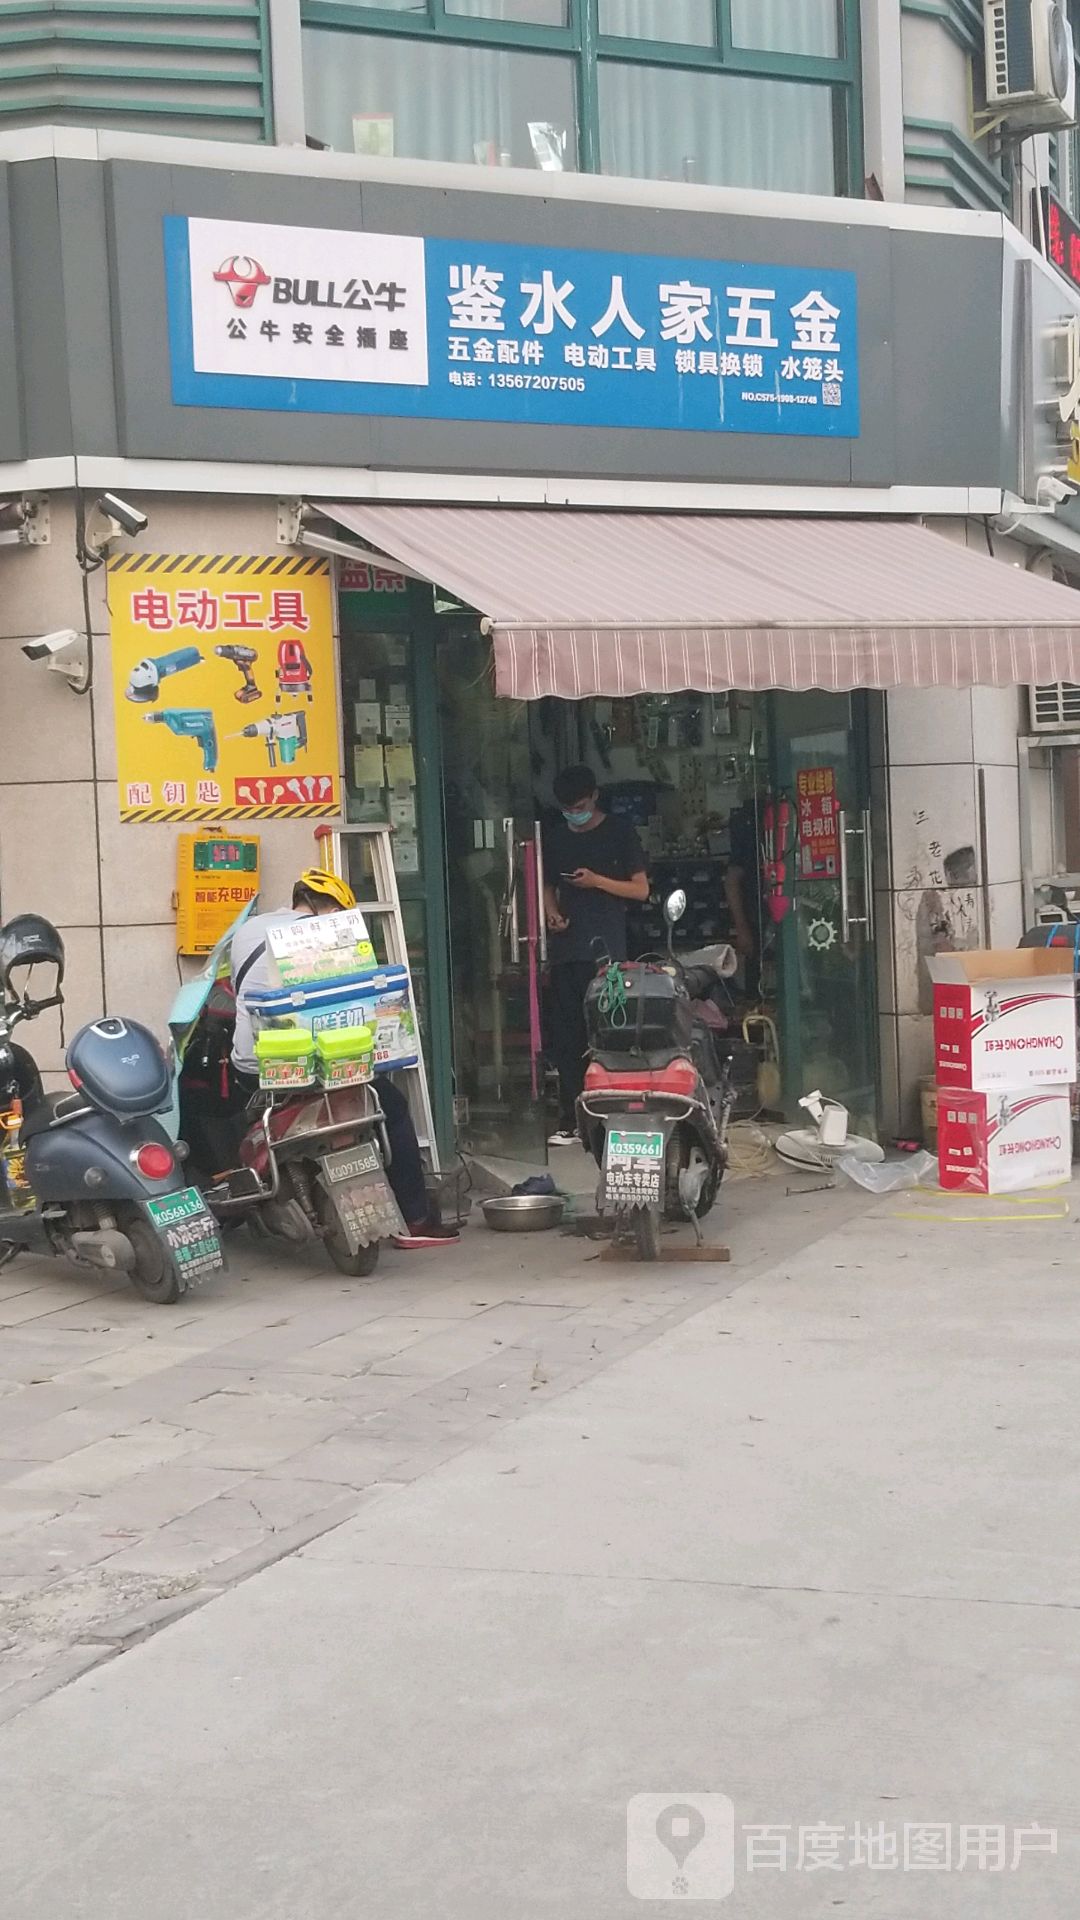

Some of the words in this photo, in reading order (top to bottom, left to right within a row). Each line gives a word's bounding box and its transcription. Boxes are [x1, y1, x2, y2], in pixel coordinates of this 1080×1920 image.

[447, 264, 841, 352] 鉴水人家五金
[226, 317, 409, 351] 公牛安全插座
[447, 336, 545, 366] 五金配件
[563, 342, 657, 373] 电动工具
[674, 349, 764, 378] 锁具换锁
[780, 355, 844, 383] 水笼头
[131, 588, 310, 632] 电动工具
[127, 780, 220, 806] 配钥匙
[800, 796, 832, 817] 冰箱
[802, 817, 836, 837] 电视机
[606, 1171, 660, 1188] 电动车专卖店
